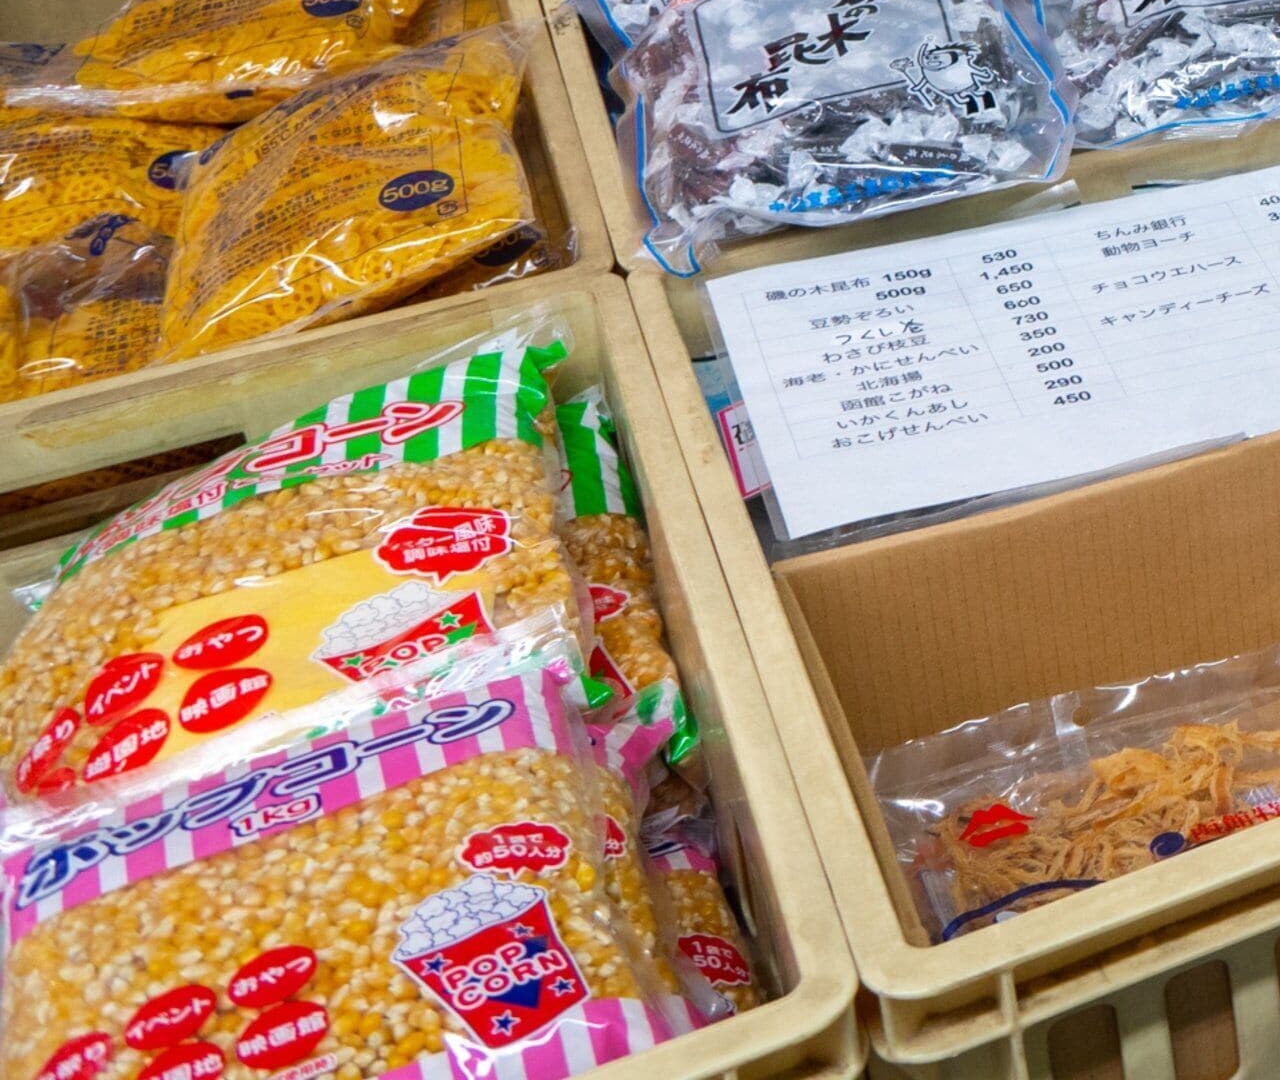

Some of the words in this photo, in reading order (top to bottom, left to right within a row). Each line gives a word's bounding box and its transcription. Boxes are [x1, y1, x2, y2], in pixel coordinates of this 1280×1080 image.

[382, 178, 451, 204] 500g
[1094, 215, 1187, 241] ちんみ銀行
[1102, 230, 1196, 258] 動物ヨーチ
[765, 276, 871, 302] 磯の木昆布
[881, 267, 932, 283] 150g
[981, 248, 1018, 265] 530
[875, 285, 927, 301] 500g
[1091, 254, 1242, 294] チョコウエハース
[808, 304, 915, 331] 豆勢ぞろい
[996, 279, 1033, 295] 650
[1099, 282, 1272, 327] キャンディーチーズ
[822, 334, 930, 364] わさび枝豆
[1011, 311, 1049, 327] 730
[1019, 326, 1057, 342] 350
[1027, 341, 1066, 357] 200
[836, 399, 968, 430] いかくんあし
[1044, 374, 1083, 390] 290
[840, 383, 952, 412] 函館こがね
[1036, 357, 1074, 374] 500
[831, 412, 989, 449] おこげせんべい
[1053, 390, 1092, 407] 450
[88, 660, 160, 716] イベント
[179, 674, 271, 723] 映画館
[14, 697, 518, 910] ポップコーン
[232, 955, 313, 998] おやつ
[442, 940, 527, 993] POP
[451, 949, 569, 1011] CORN
